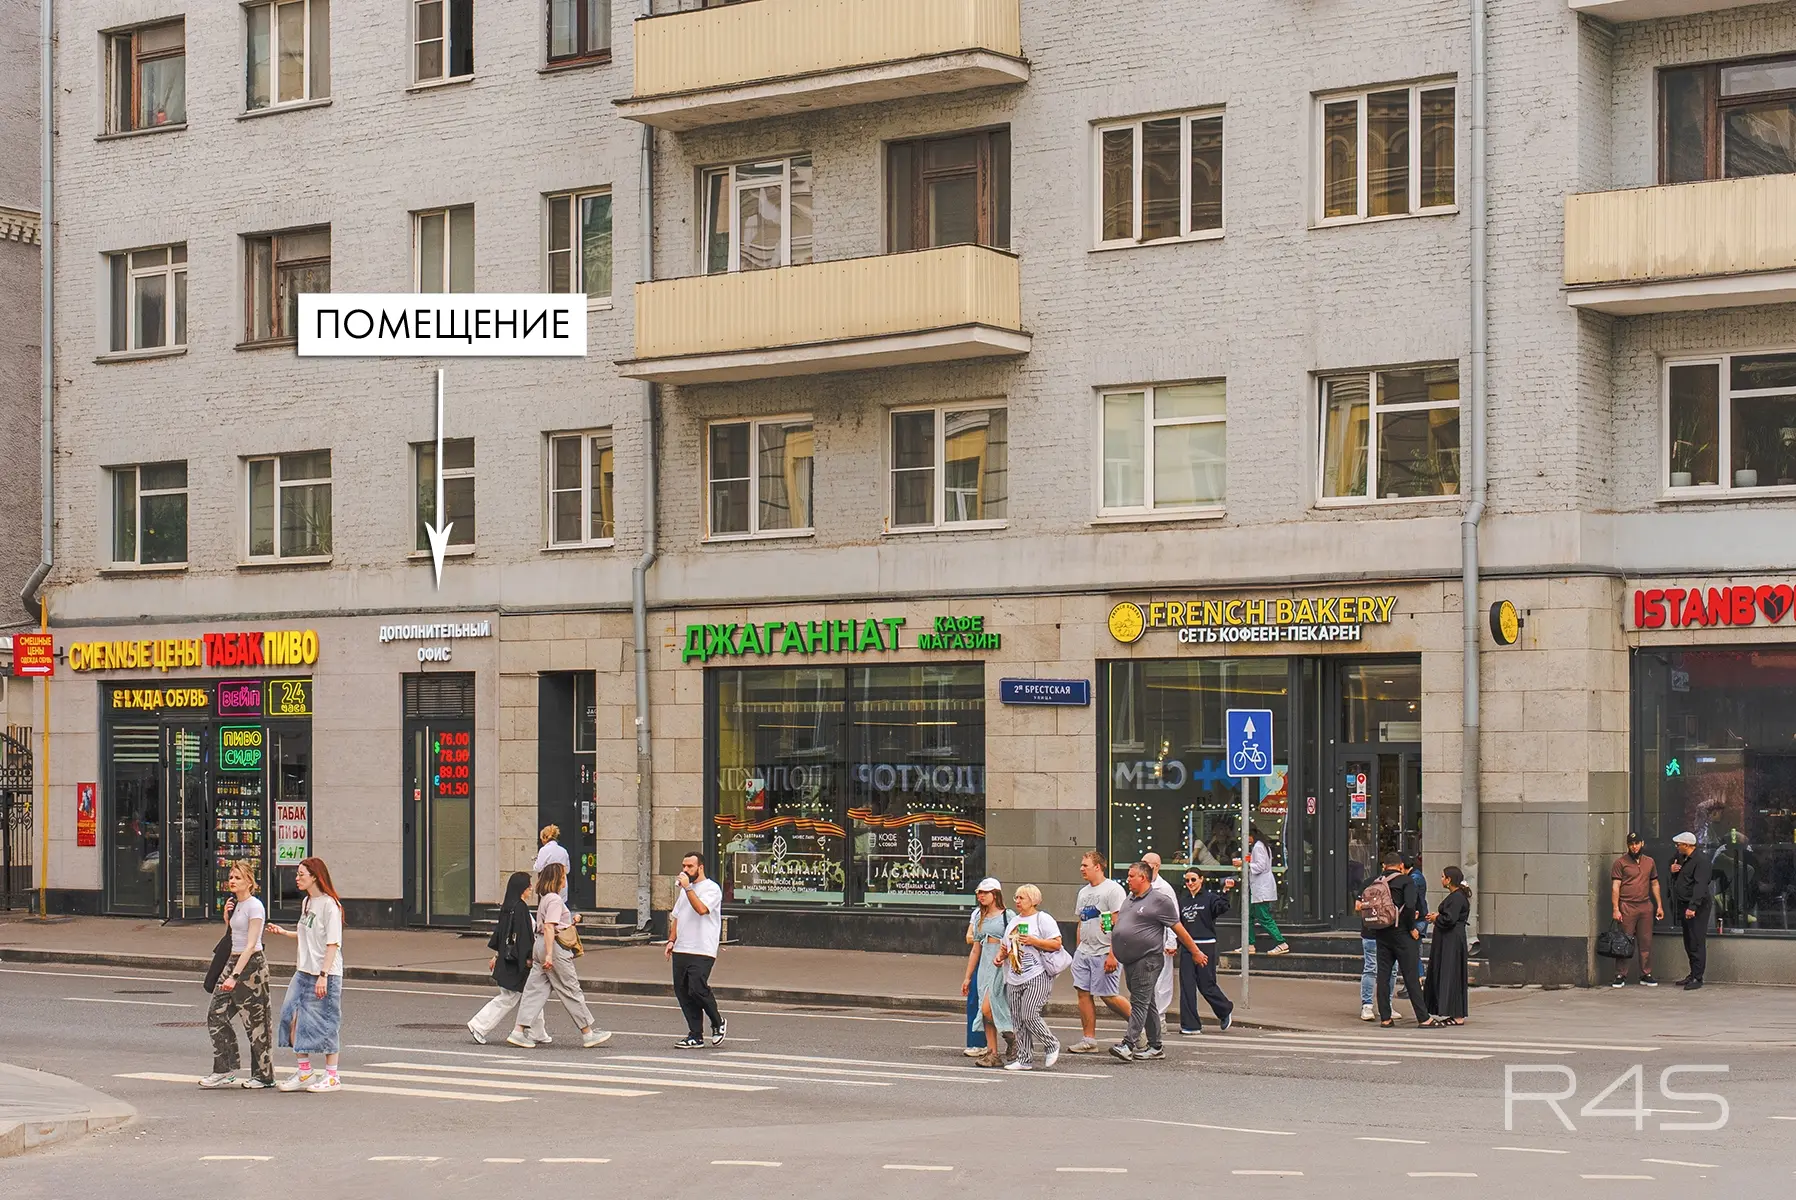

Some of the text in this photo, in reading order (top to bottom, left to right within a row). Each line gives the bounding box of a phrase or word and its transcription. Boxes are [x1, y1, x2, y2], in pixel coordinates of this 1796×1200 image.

[1149, 596, 1398, 627] FRENCH BAKERY
[379, 620, 491, 642] ДОПОЛНИТЕЛЬНЫЙ
[934, 615, 984, 632] КАФЕ
[20, 637, 51, 646] СМЕШНЫЕ
[682, 617, 905, 663] ДЖАГАННАТ
[918, 633, 1001, 650] МАГАЗИН
[1178, 625, 1361, 643] СЕТЬ КОФЕЕН-ПЕКАРЕН
[27, 647, 44, 656] ЦЕНЫ
[154, 639, 202, 672] ЦЕНЫ
[203, 629, 319, 666] ТАБАК ПИВО
[417, 647, 452, 662] ОФИС
[165, 688, 208, 707] ОБУВЬ
[222, 686, 261, 707] ВЕЙП
[281, 682, 306, 704] 24
[1025, 685, 1071, 694] БРЕСТСКАЯ
[223, 731, 262, 747] ПИВО
[440, 732, 469, 746] 76.00
[225, 750, 261, 767] СИДР
[440, 749, 469, 763] 78.00
[440, 782, 469, 795] 91.50
[277, 806, 306, 820] ТАБАК
[278, 825, 306, 840] ПИВО
[878, 833, 897, 841] КОФЕ
[279, 846, 305, 859] 24/7
